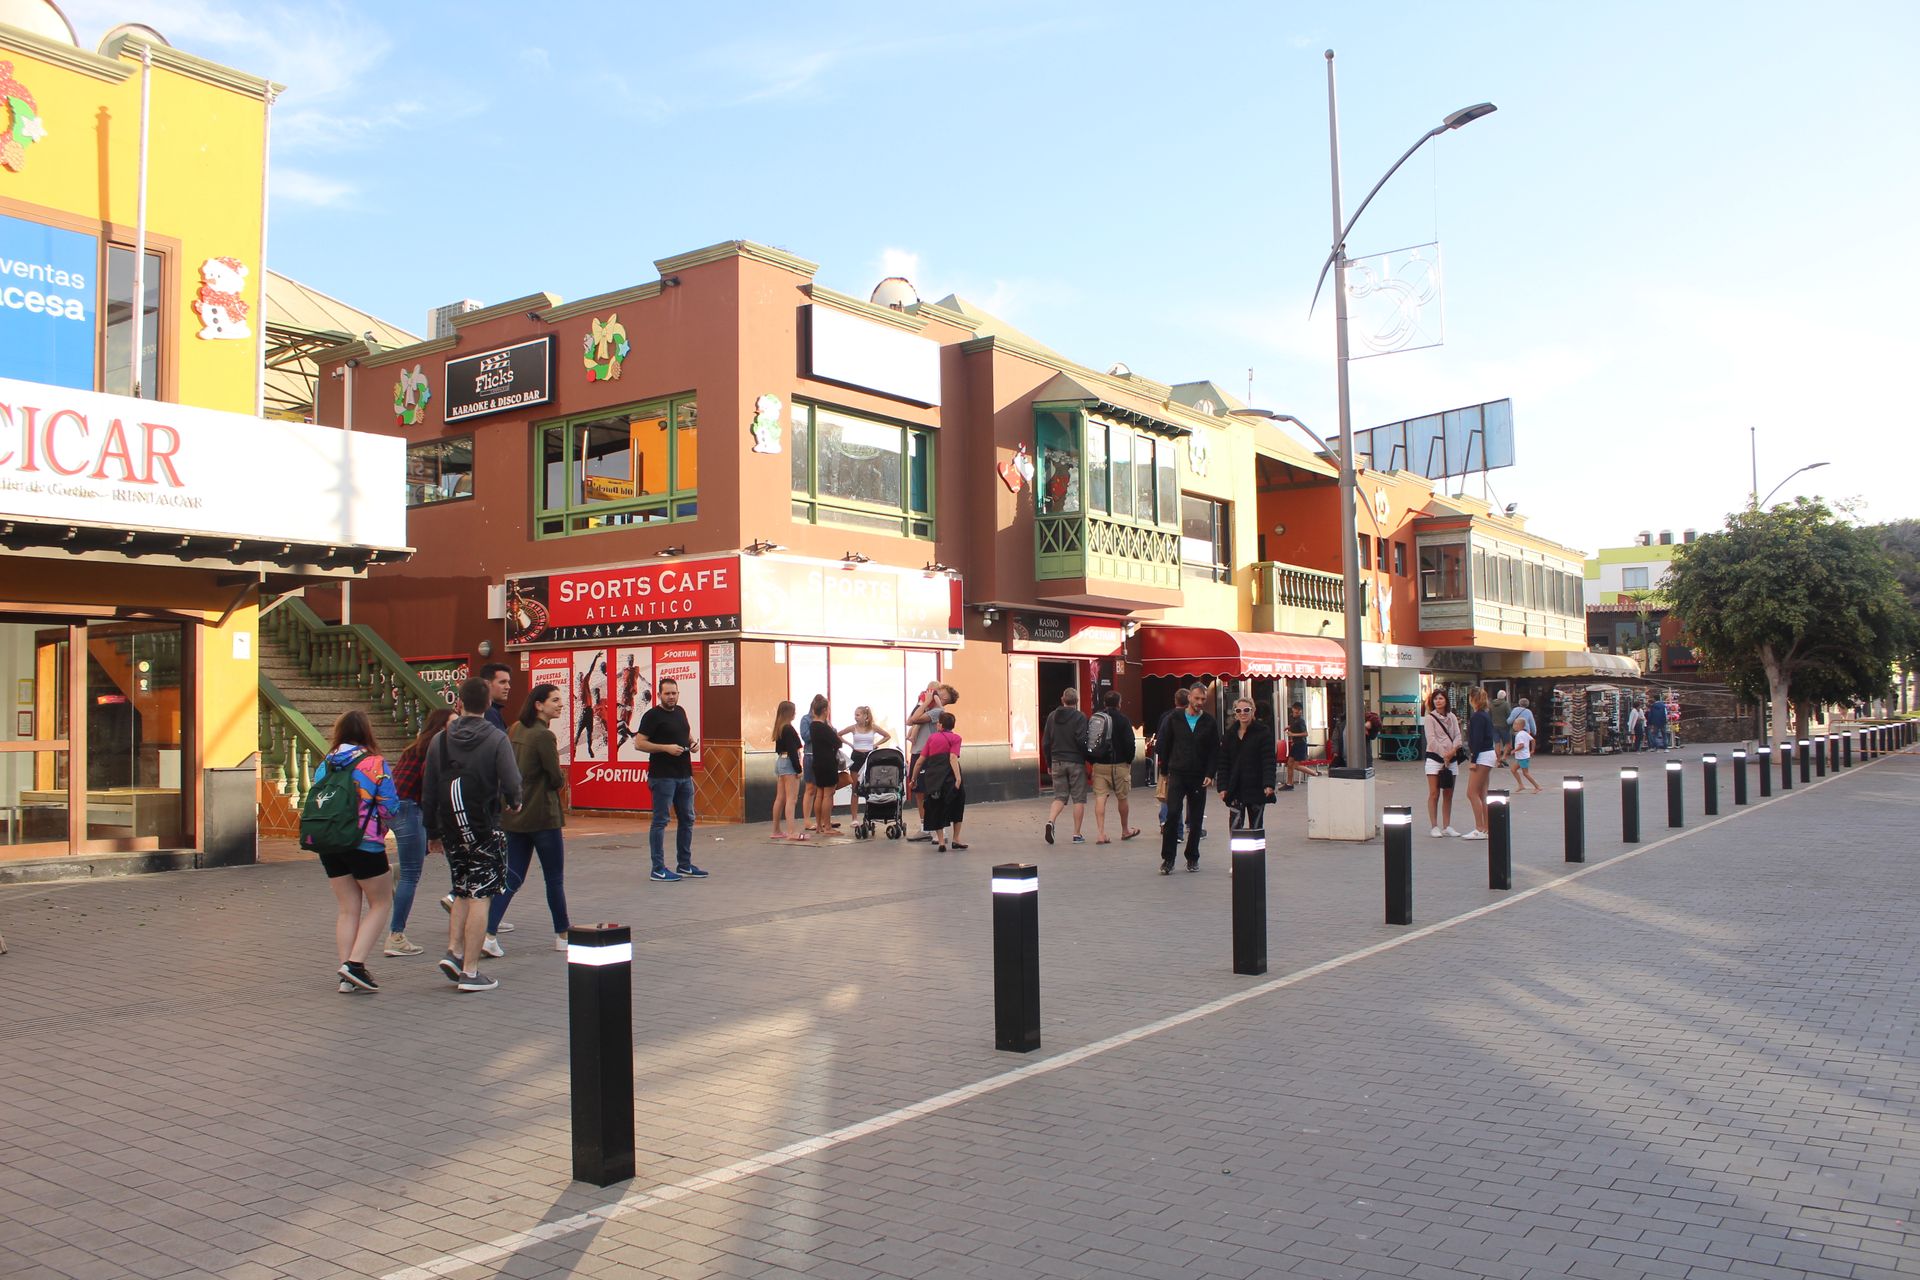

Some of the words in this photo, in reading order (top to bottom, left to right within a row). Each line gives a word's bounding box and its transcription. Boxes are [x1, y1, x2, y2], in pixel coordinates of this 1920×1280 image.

[0, 286, 86, 322] cesa
[475, 370, 514, 393] Flicks
[452, 400, 489, 416] KARAOKE
[490, 399, 497, 408] &
[498, 393, 522, 407] DISCO
[523, 389, 540, 401] BAR
[559, 576, 651, 602] SPORTS
[658, 568, 728, 593] CAFE
[586, 599, 693, 620] ATLANTICO
[1039, 618, 1060, 629] KASINO
[536, 656, 568, 667] SPORTIUM
[659, 649, 697, 660] SPORTIUM
[536, 672, 561, 681] APUESTAS
[661, 666, 690, 675] APUESTAS
